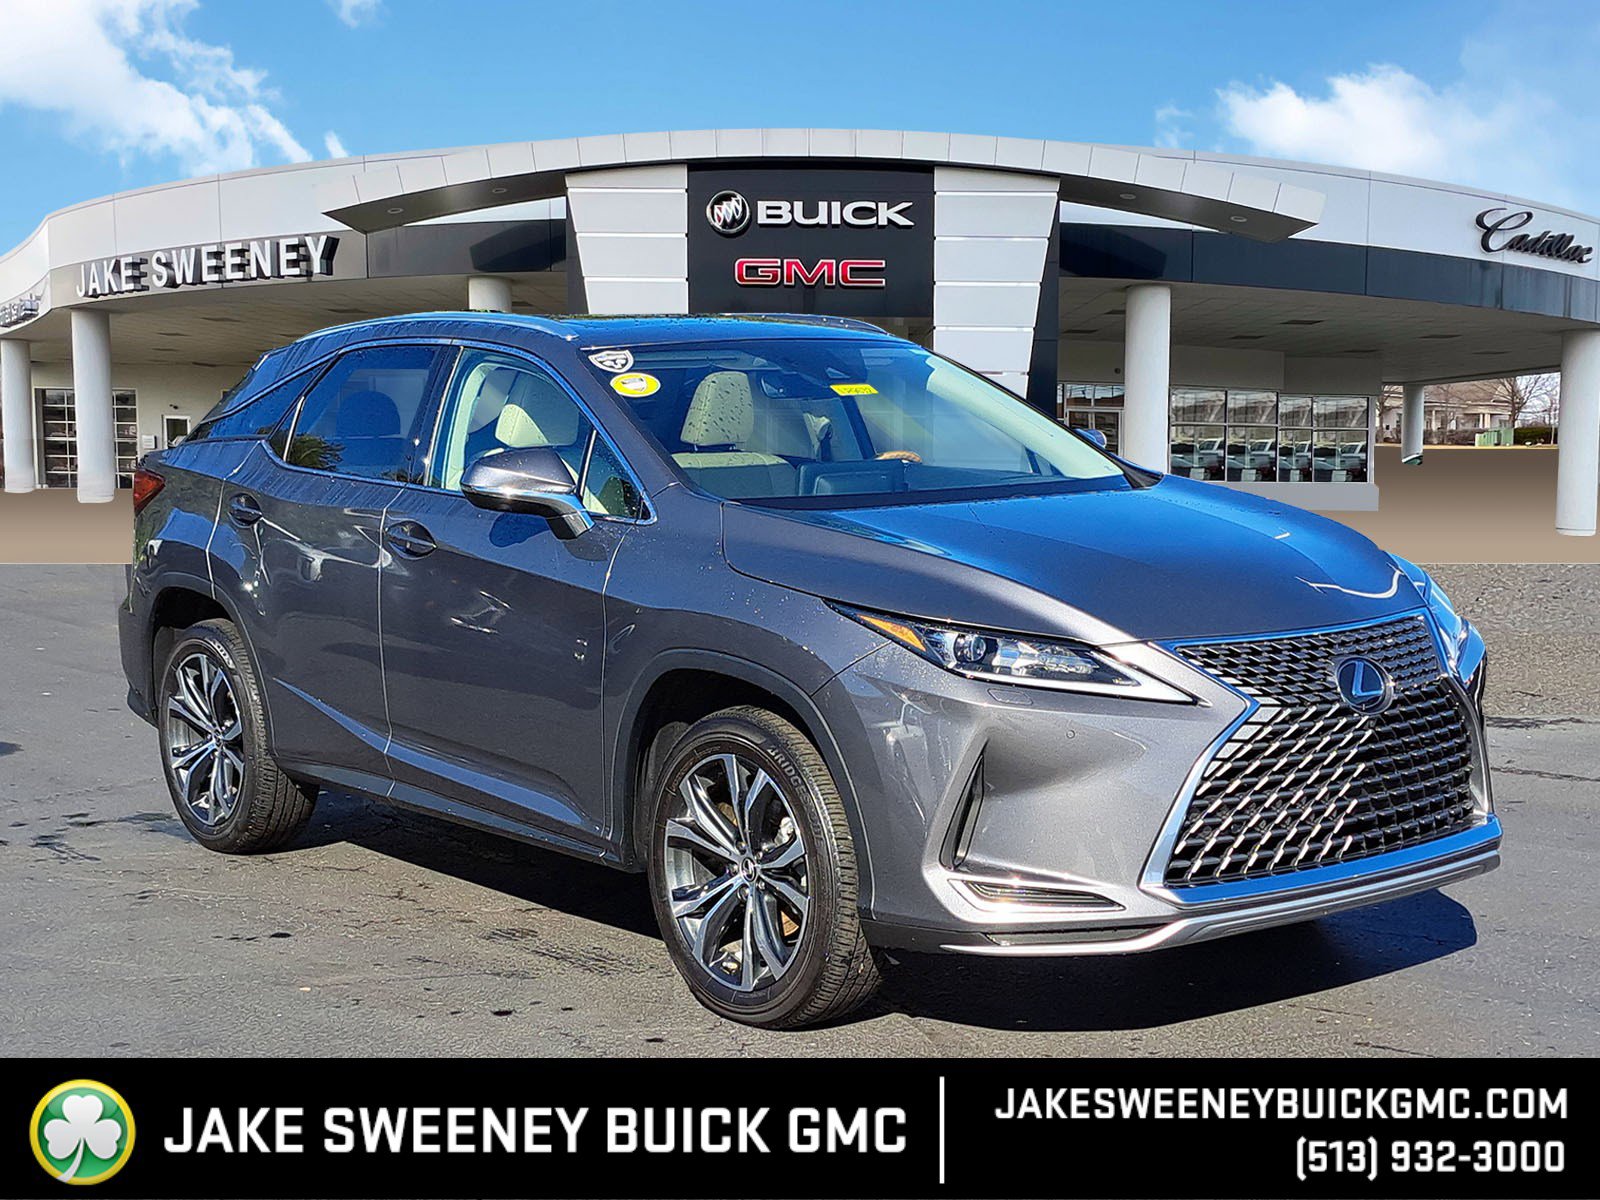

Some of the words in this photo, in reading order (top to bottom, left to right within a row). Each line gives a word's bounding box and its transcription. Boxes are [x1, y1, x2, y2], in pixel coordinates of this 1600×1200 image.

[757, 200, 915, 227] BUICK
[1475, 207, 1593, 264] Cadillac
[76, 256, 145, 298] JAKE
[151, 235, 337, 288] SWEENEY
[734, 258, 886, 287] GMC
[767, 745, 825, 847] BRIDGESONE
